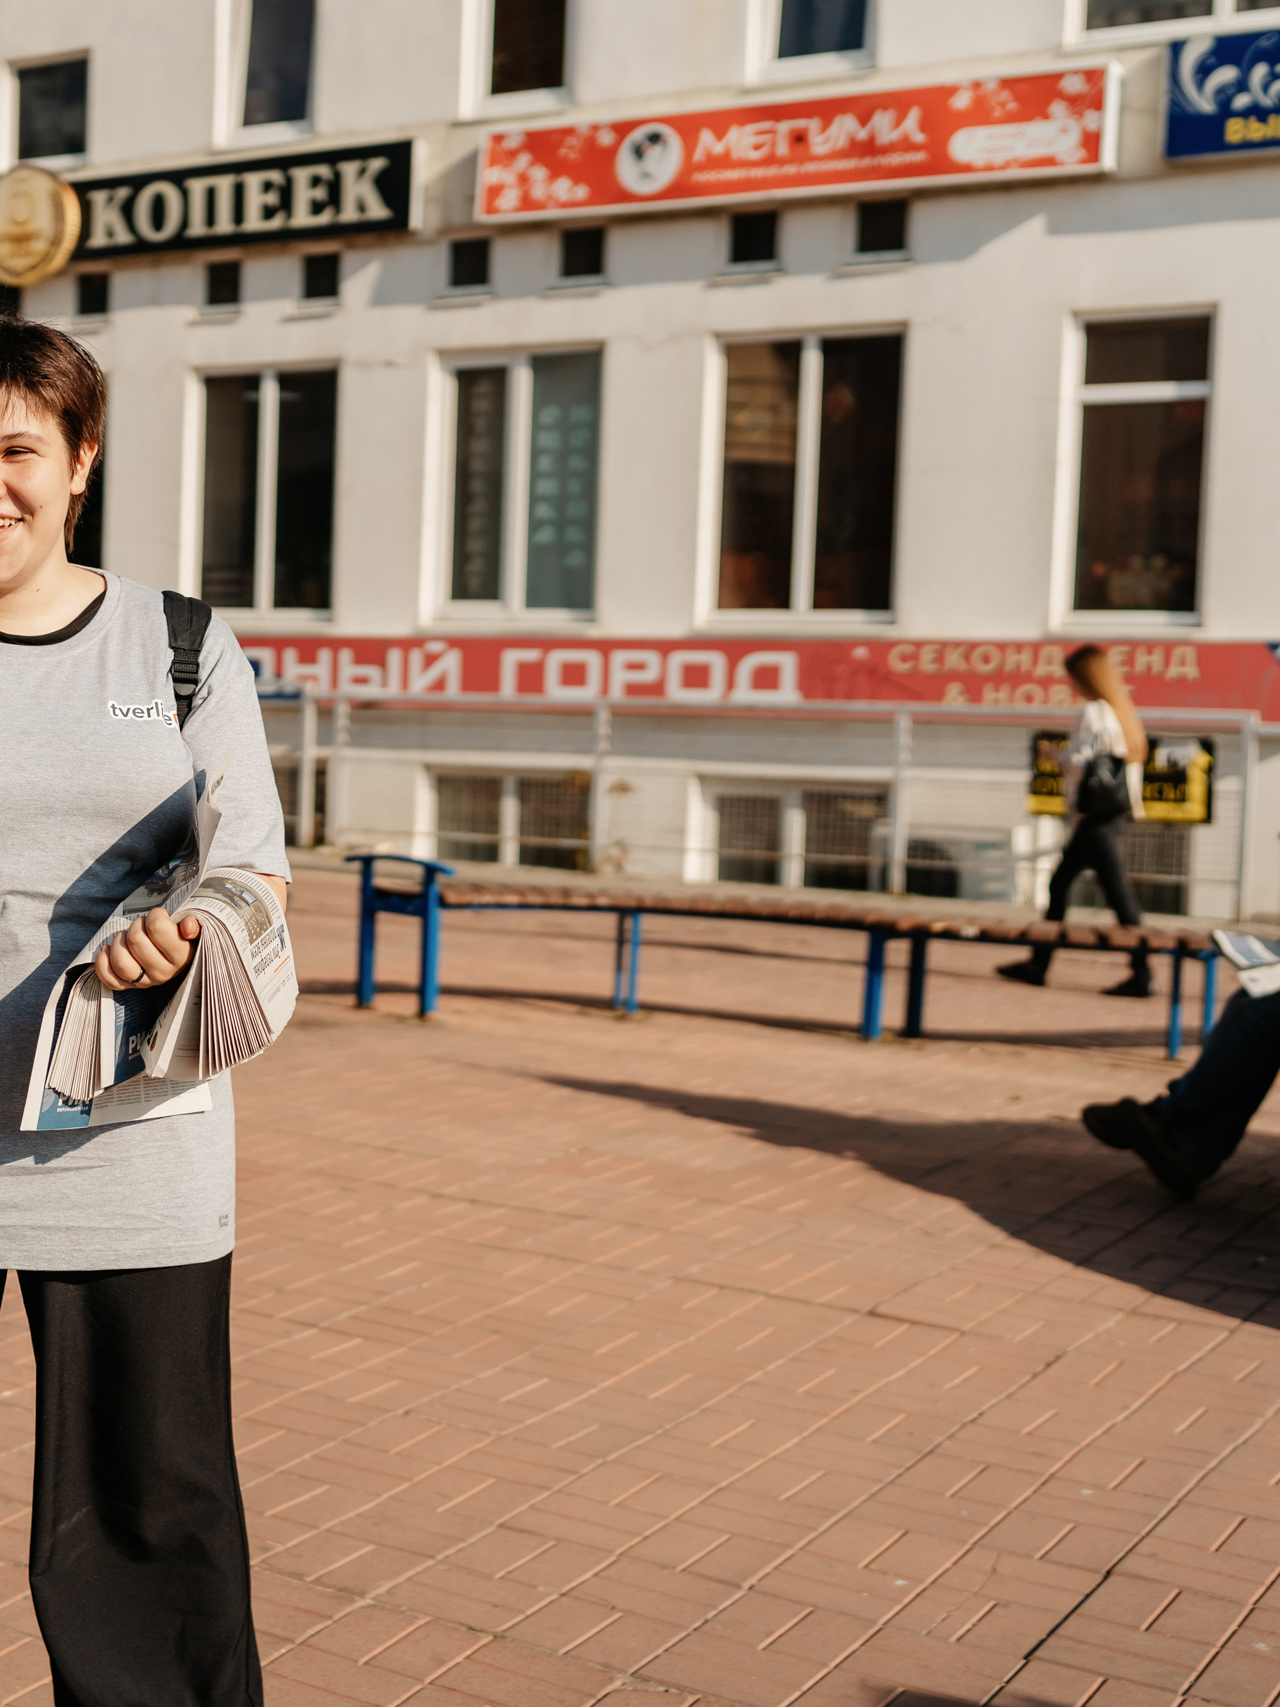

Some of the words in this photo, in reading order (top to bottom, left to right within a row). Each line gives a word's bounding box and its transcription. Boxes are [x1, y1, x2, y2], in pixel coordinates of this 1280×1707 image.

[692, 105, 928, 164] МЕГУМИ
[84, 156, 394, 249] КОПЕЕК
[242, 640, 465, 697] ДНЫЙ
[499, 647, 805, 701] ГОРОД
[886, 643, 1066, 681] СЕКОНД
[1107, 644, 1202, 681] ЕНД
